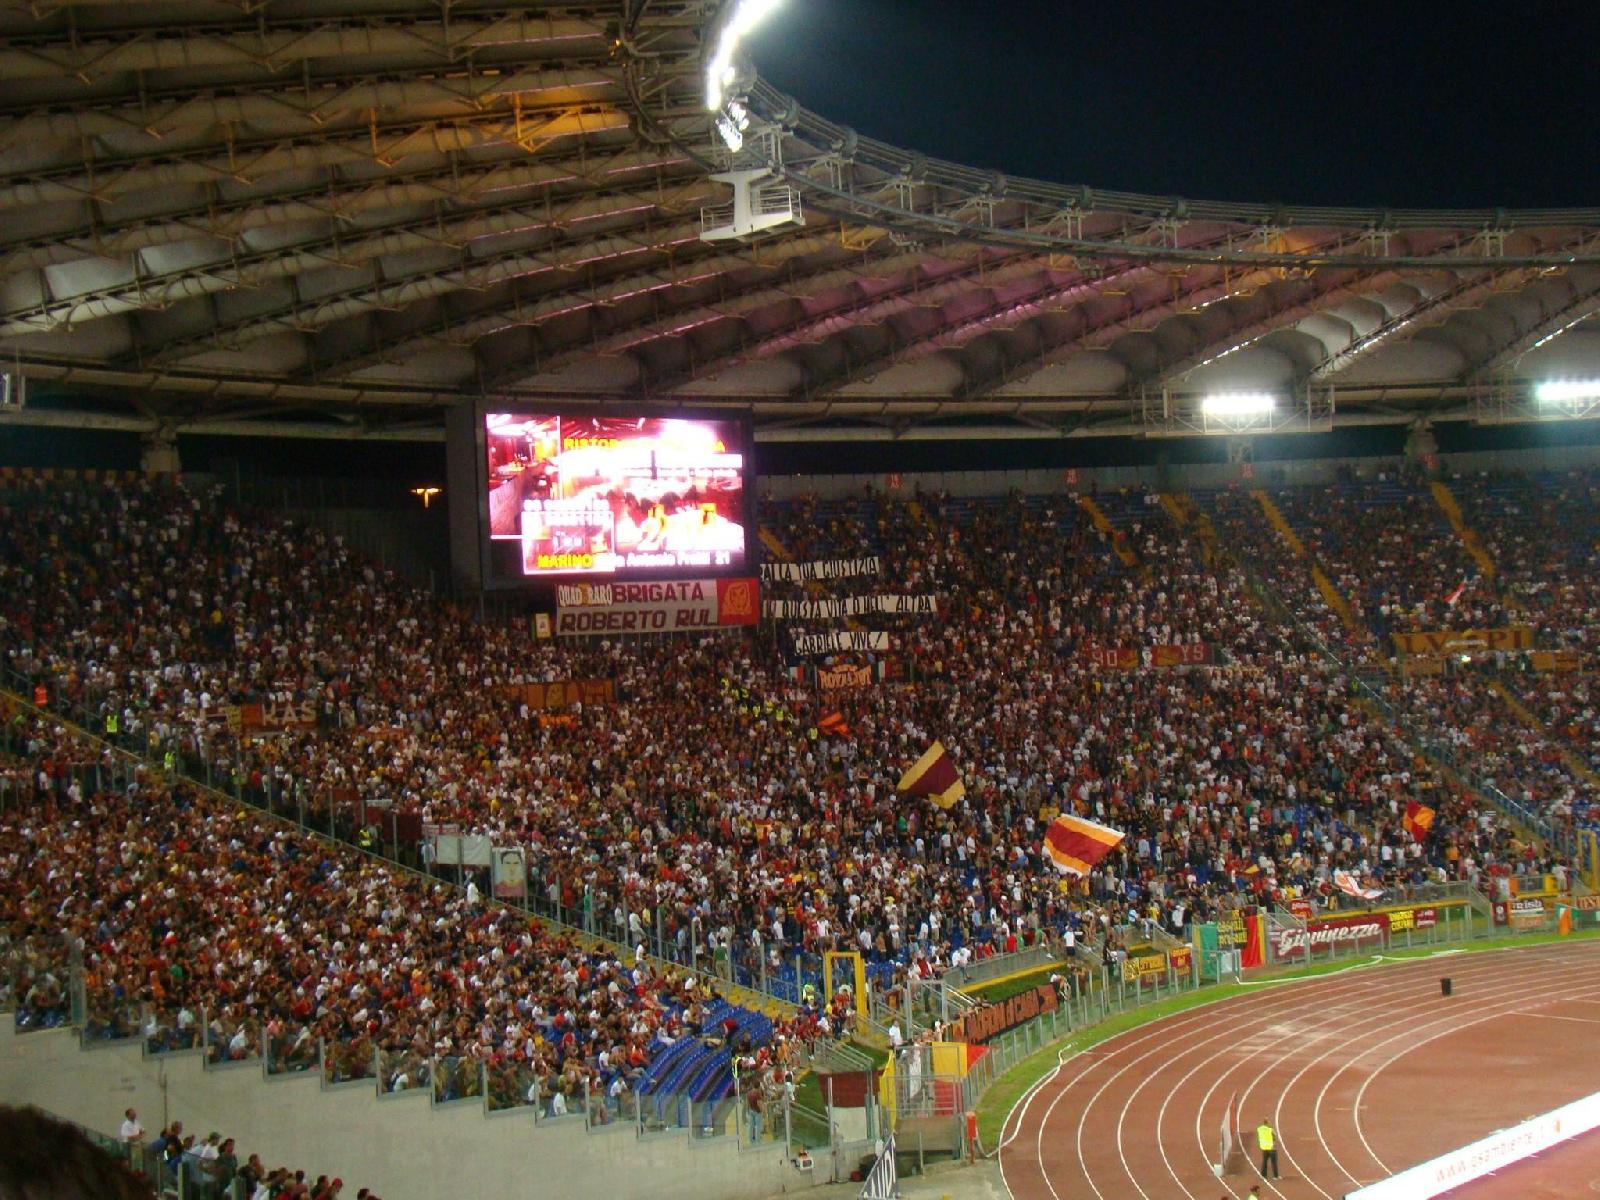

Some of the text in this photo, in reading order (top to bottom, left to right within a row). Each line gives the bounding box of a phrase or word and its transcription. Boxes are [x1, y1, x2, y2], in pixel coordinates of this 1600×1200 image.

[537, 554, 593, 568] MARINO
[612, 582, 704, 603] BRIGATA
[560, 609, 667, 632] ROBERTO
